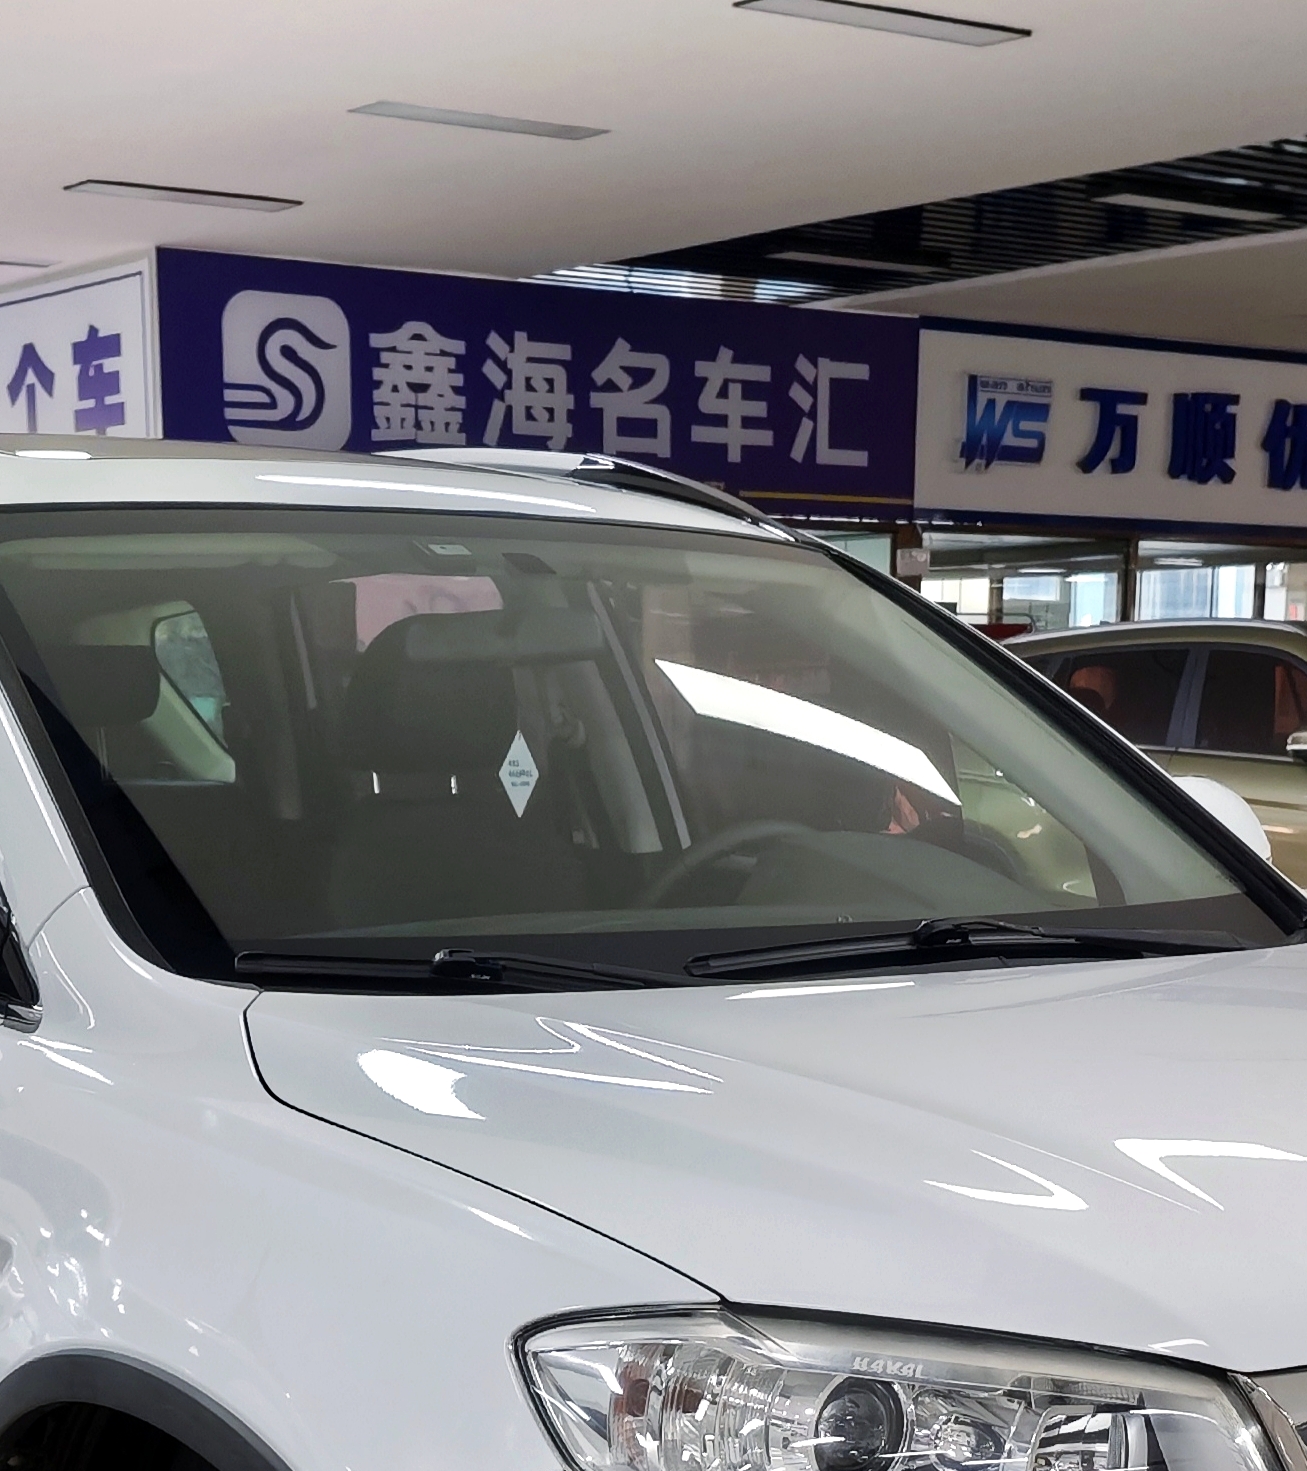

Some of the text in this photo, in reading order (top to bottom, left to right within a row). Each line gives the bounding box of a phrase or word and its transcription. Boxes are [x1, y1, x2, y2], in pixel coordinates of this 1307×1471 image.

[368, 320, 871, 467] 鑫海名车汇
